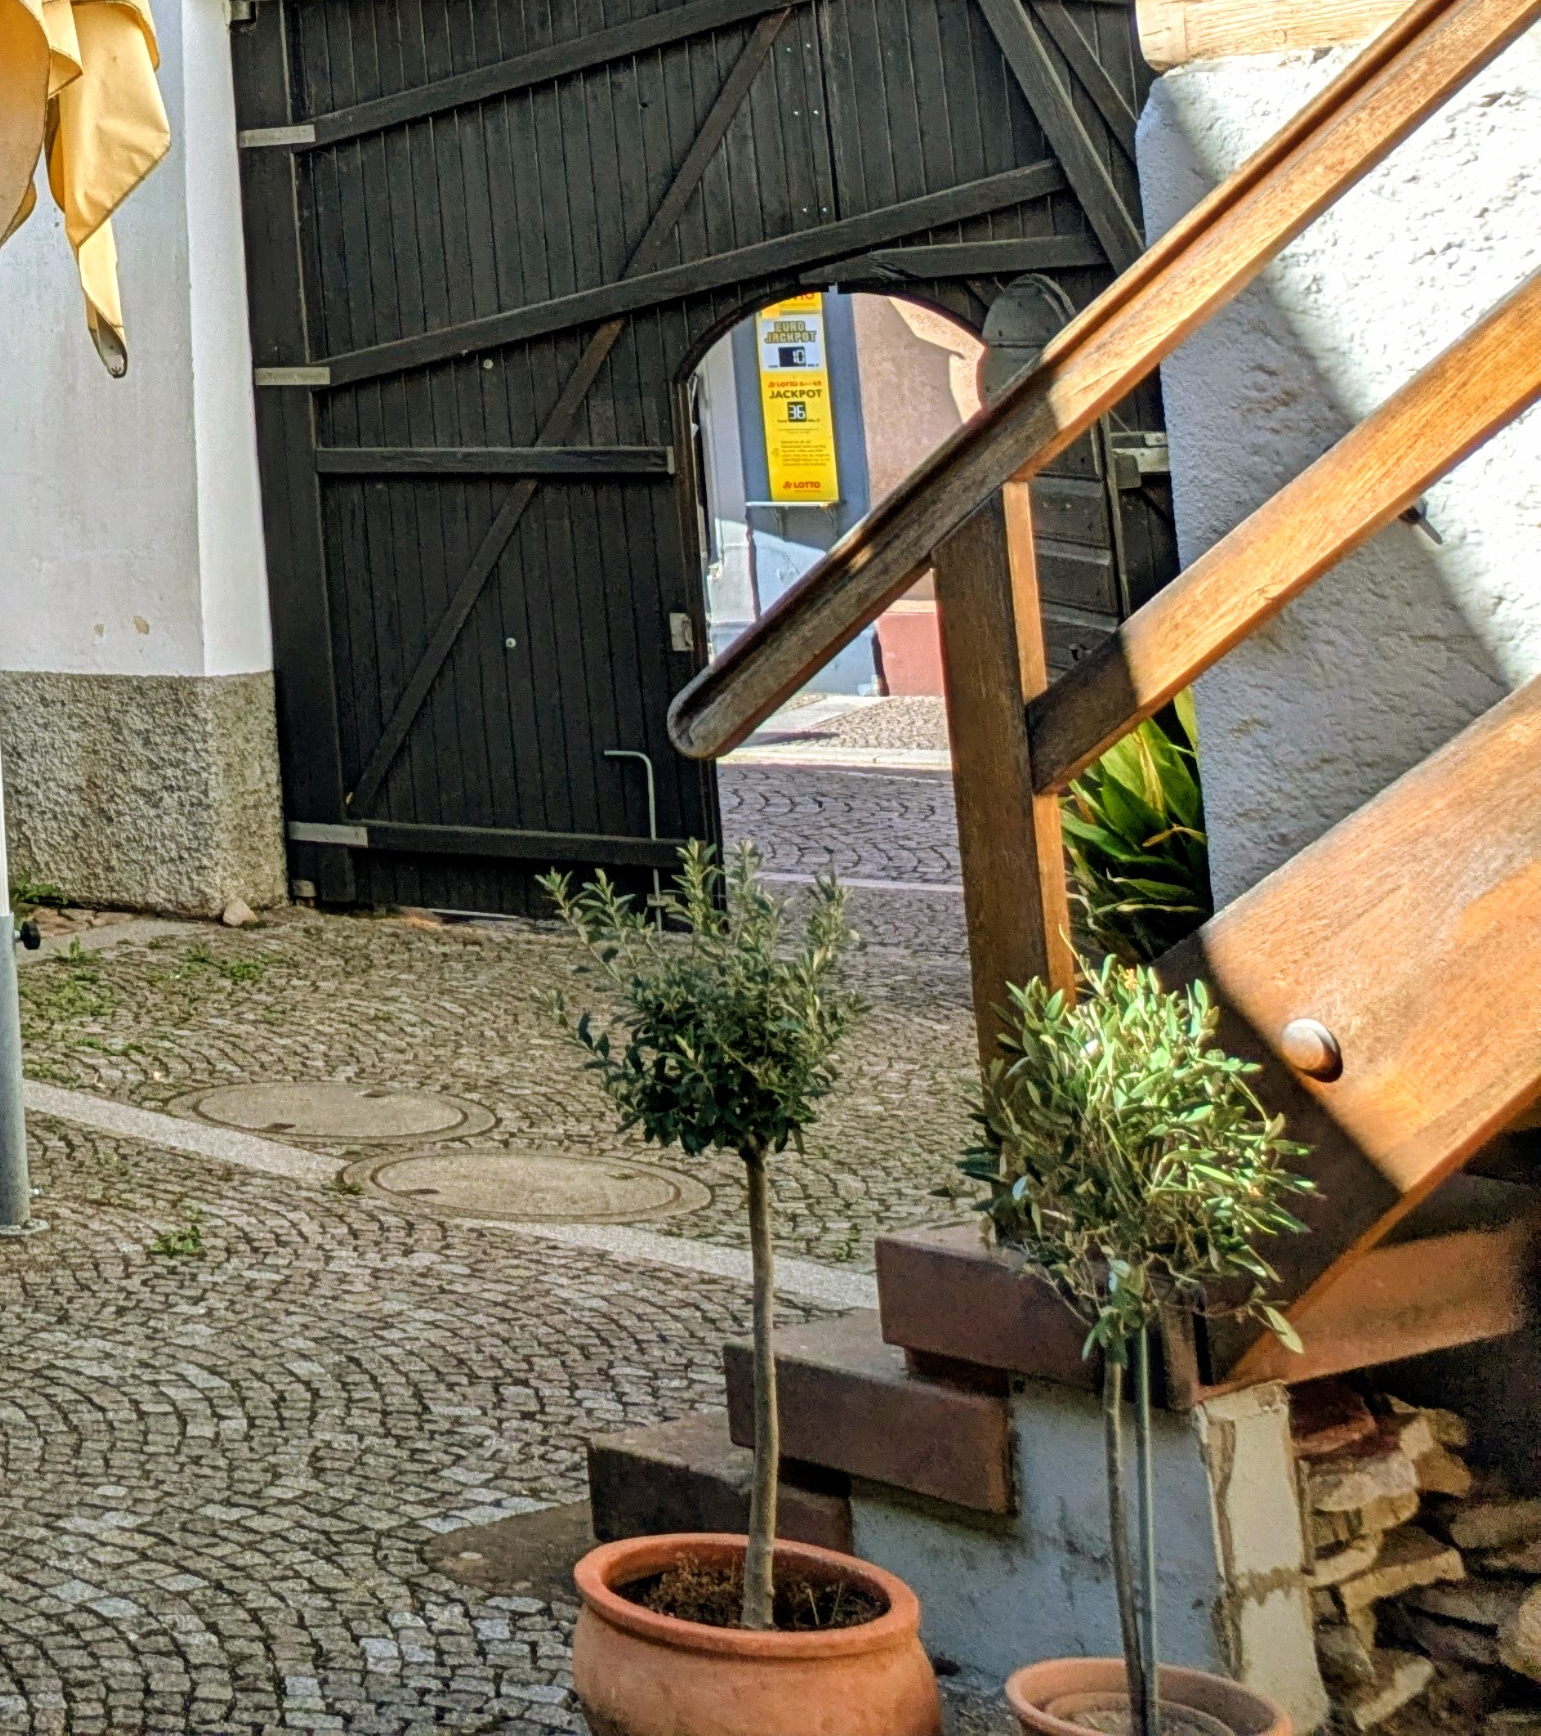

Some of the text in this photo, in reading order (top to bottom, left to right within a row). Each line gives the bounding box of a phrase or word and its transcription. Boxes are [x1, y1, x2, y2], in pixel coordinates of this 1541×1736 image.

[774, 321, 806, 331] EURO
[764, 331, 816, 343] JACKPOT
[793, 349, 805, 363] 10
[769, 389, 822, 399] JACKPOT
[789, 405, 806, 419] 36
